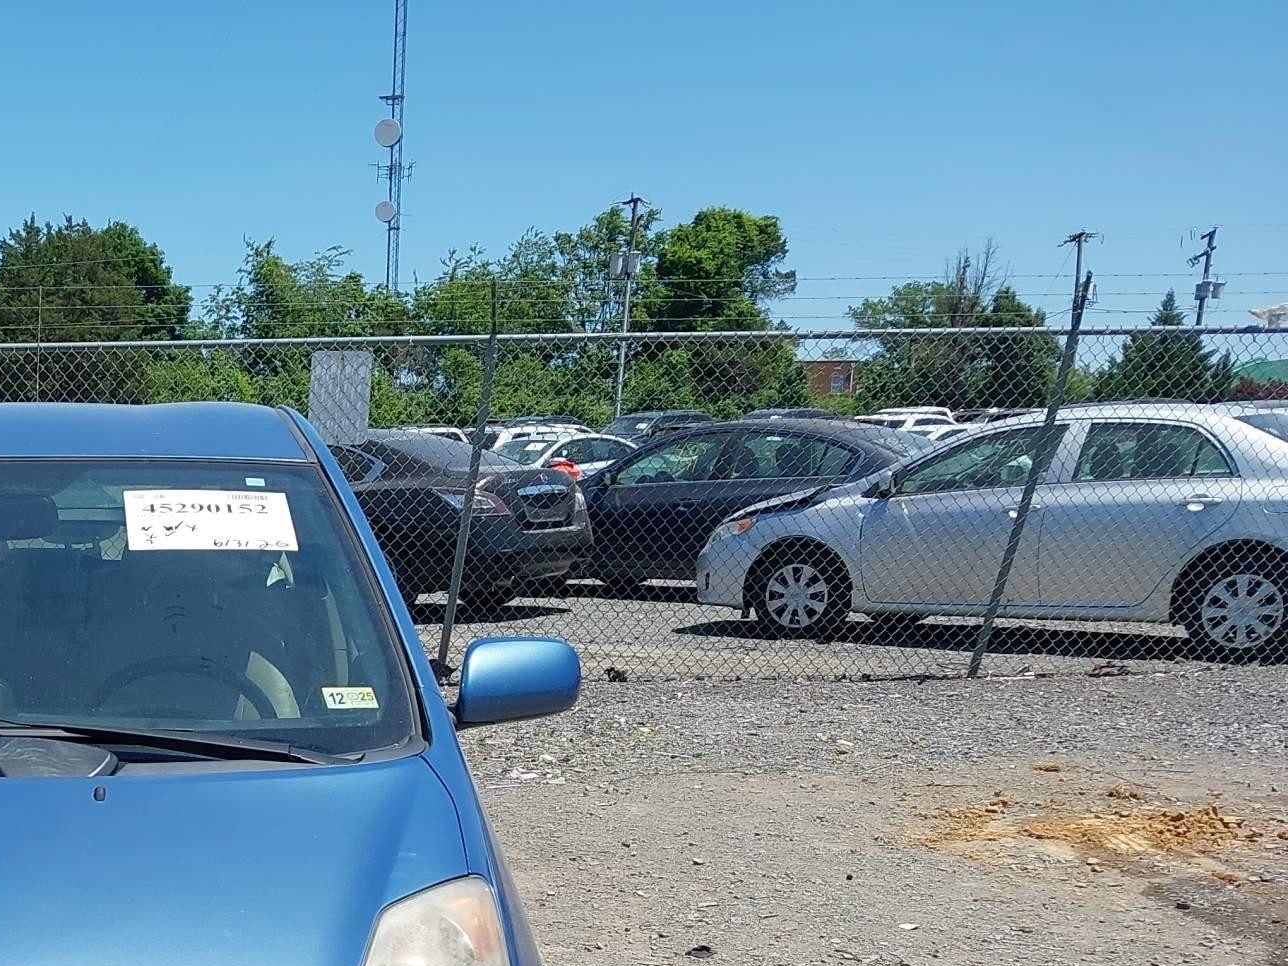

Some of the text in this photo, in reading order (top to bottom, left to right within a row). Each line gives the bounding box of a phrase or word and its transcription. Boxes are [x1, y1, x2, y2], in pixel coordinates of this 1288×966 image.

[142, 503, 269, 514] 45290152
[328, 691, 374, 705] 12 25
